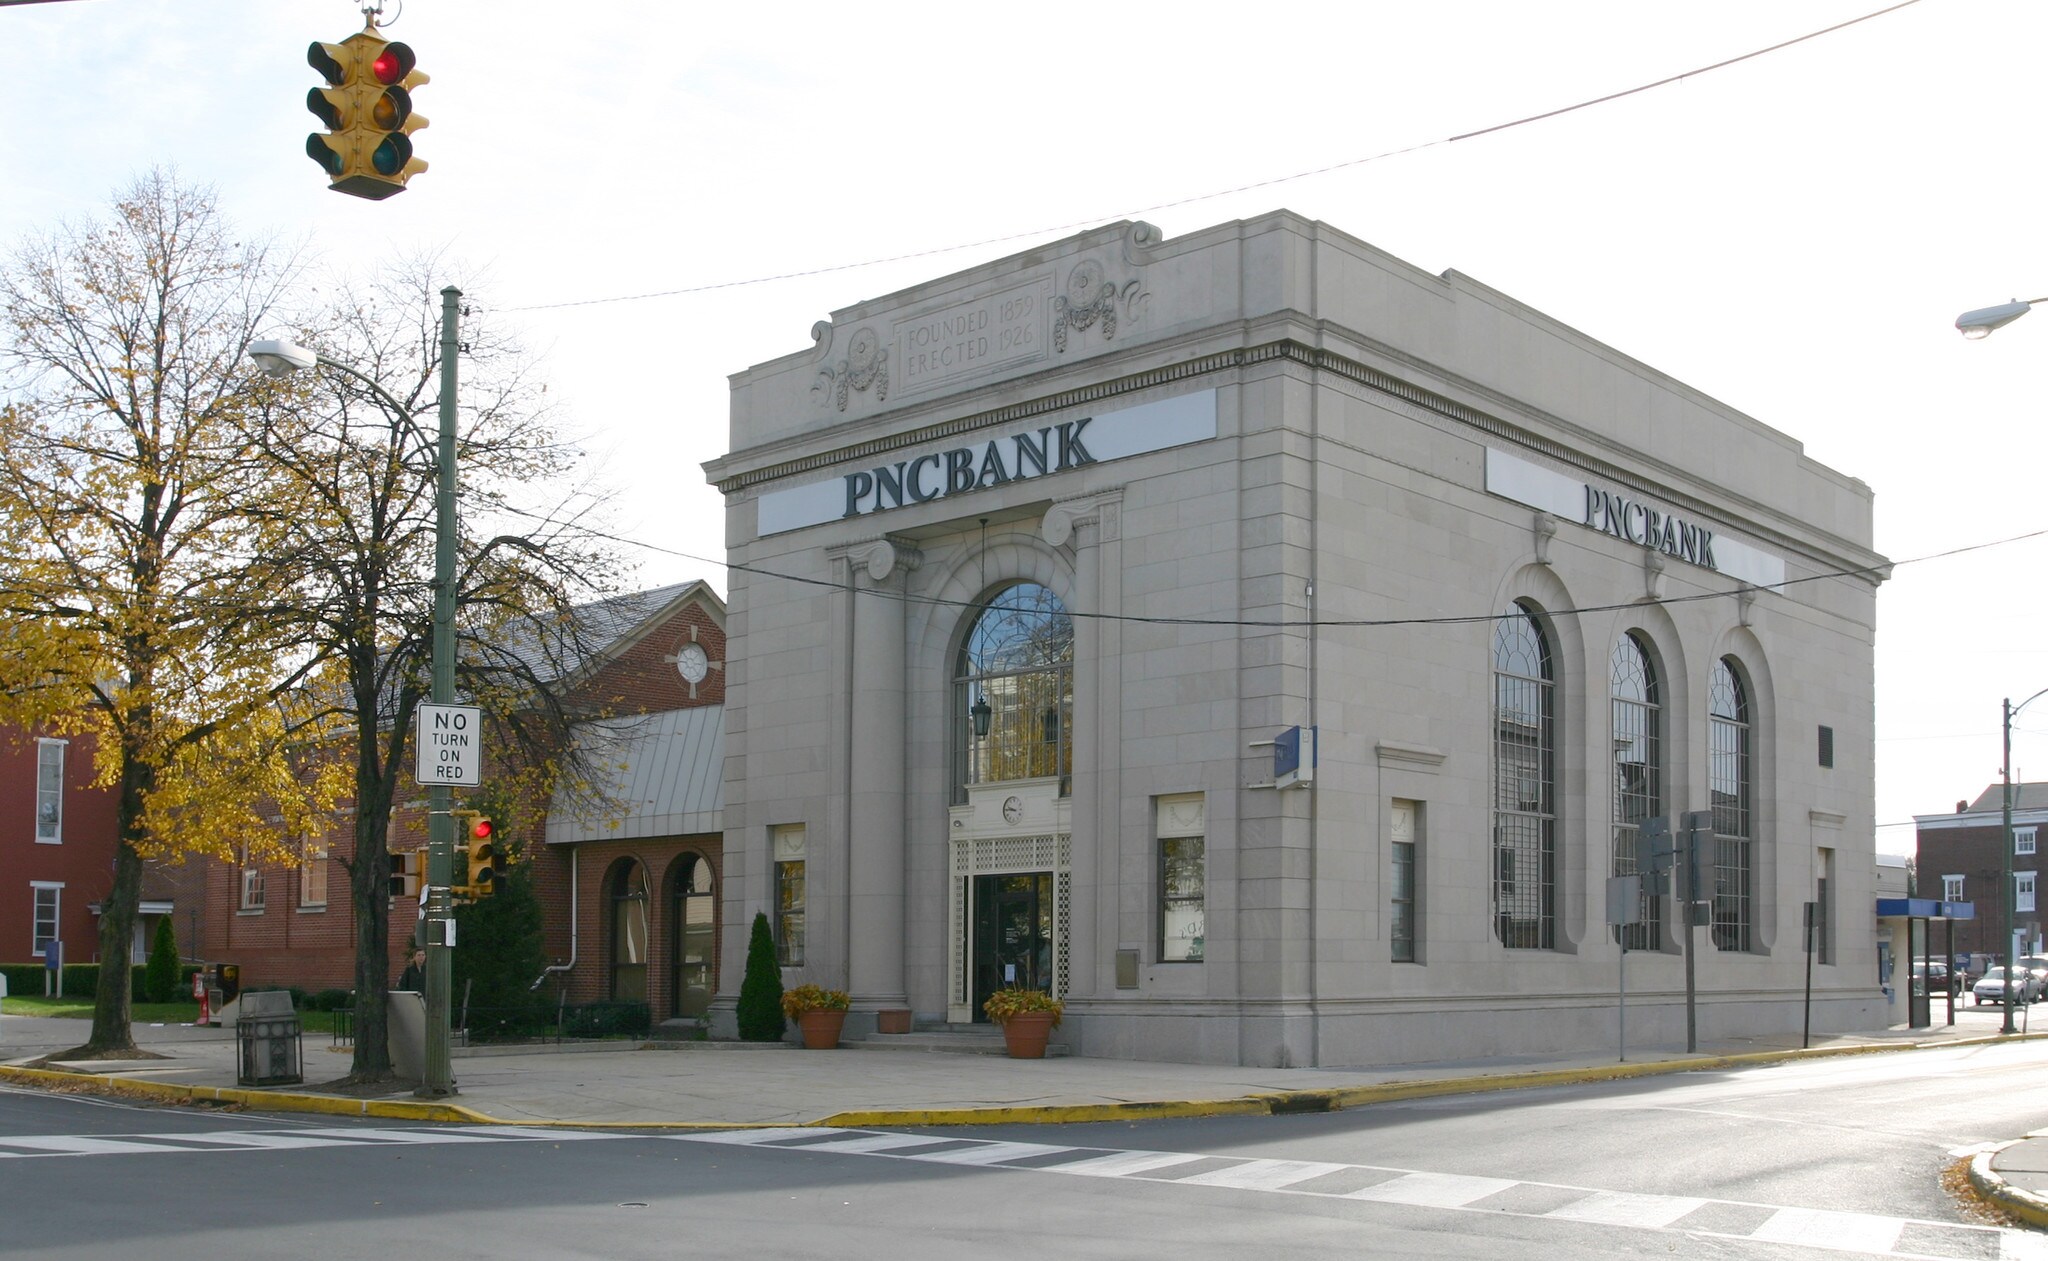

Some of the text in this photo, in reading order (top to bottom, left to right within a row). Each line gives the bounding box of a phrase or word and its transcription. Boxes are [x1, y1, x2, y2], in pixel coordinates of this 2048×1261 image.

[909, 309, 989, 350] FOUNDED
[908, 323, 1033, 376] ERECTED 1926
[435, 712, 467, 731] NO
[432, 733, 468, 747] TURN
[440, 749, 460, 762] ON
[436, 765, 463, 779] RED
